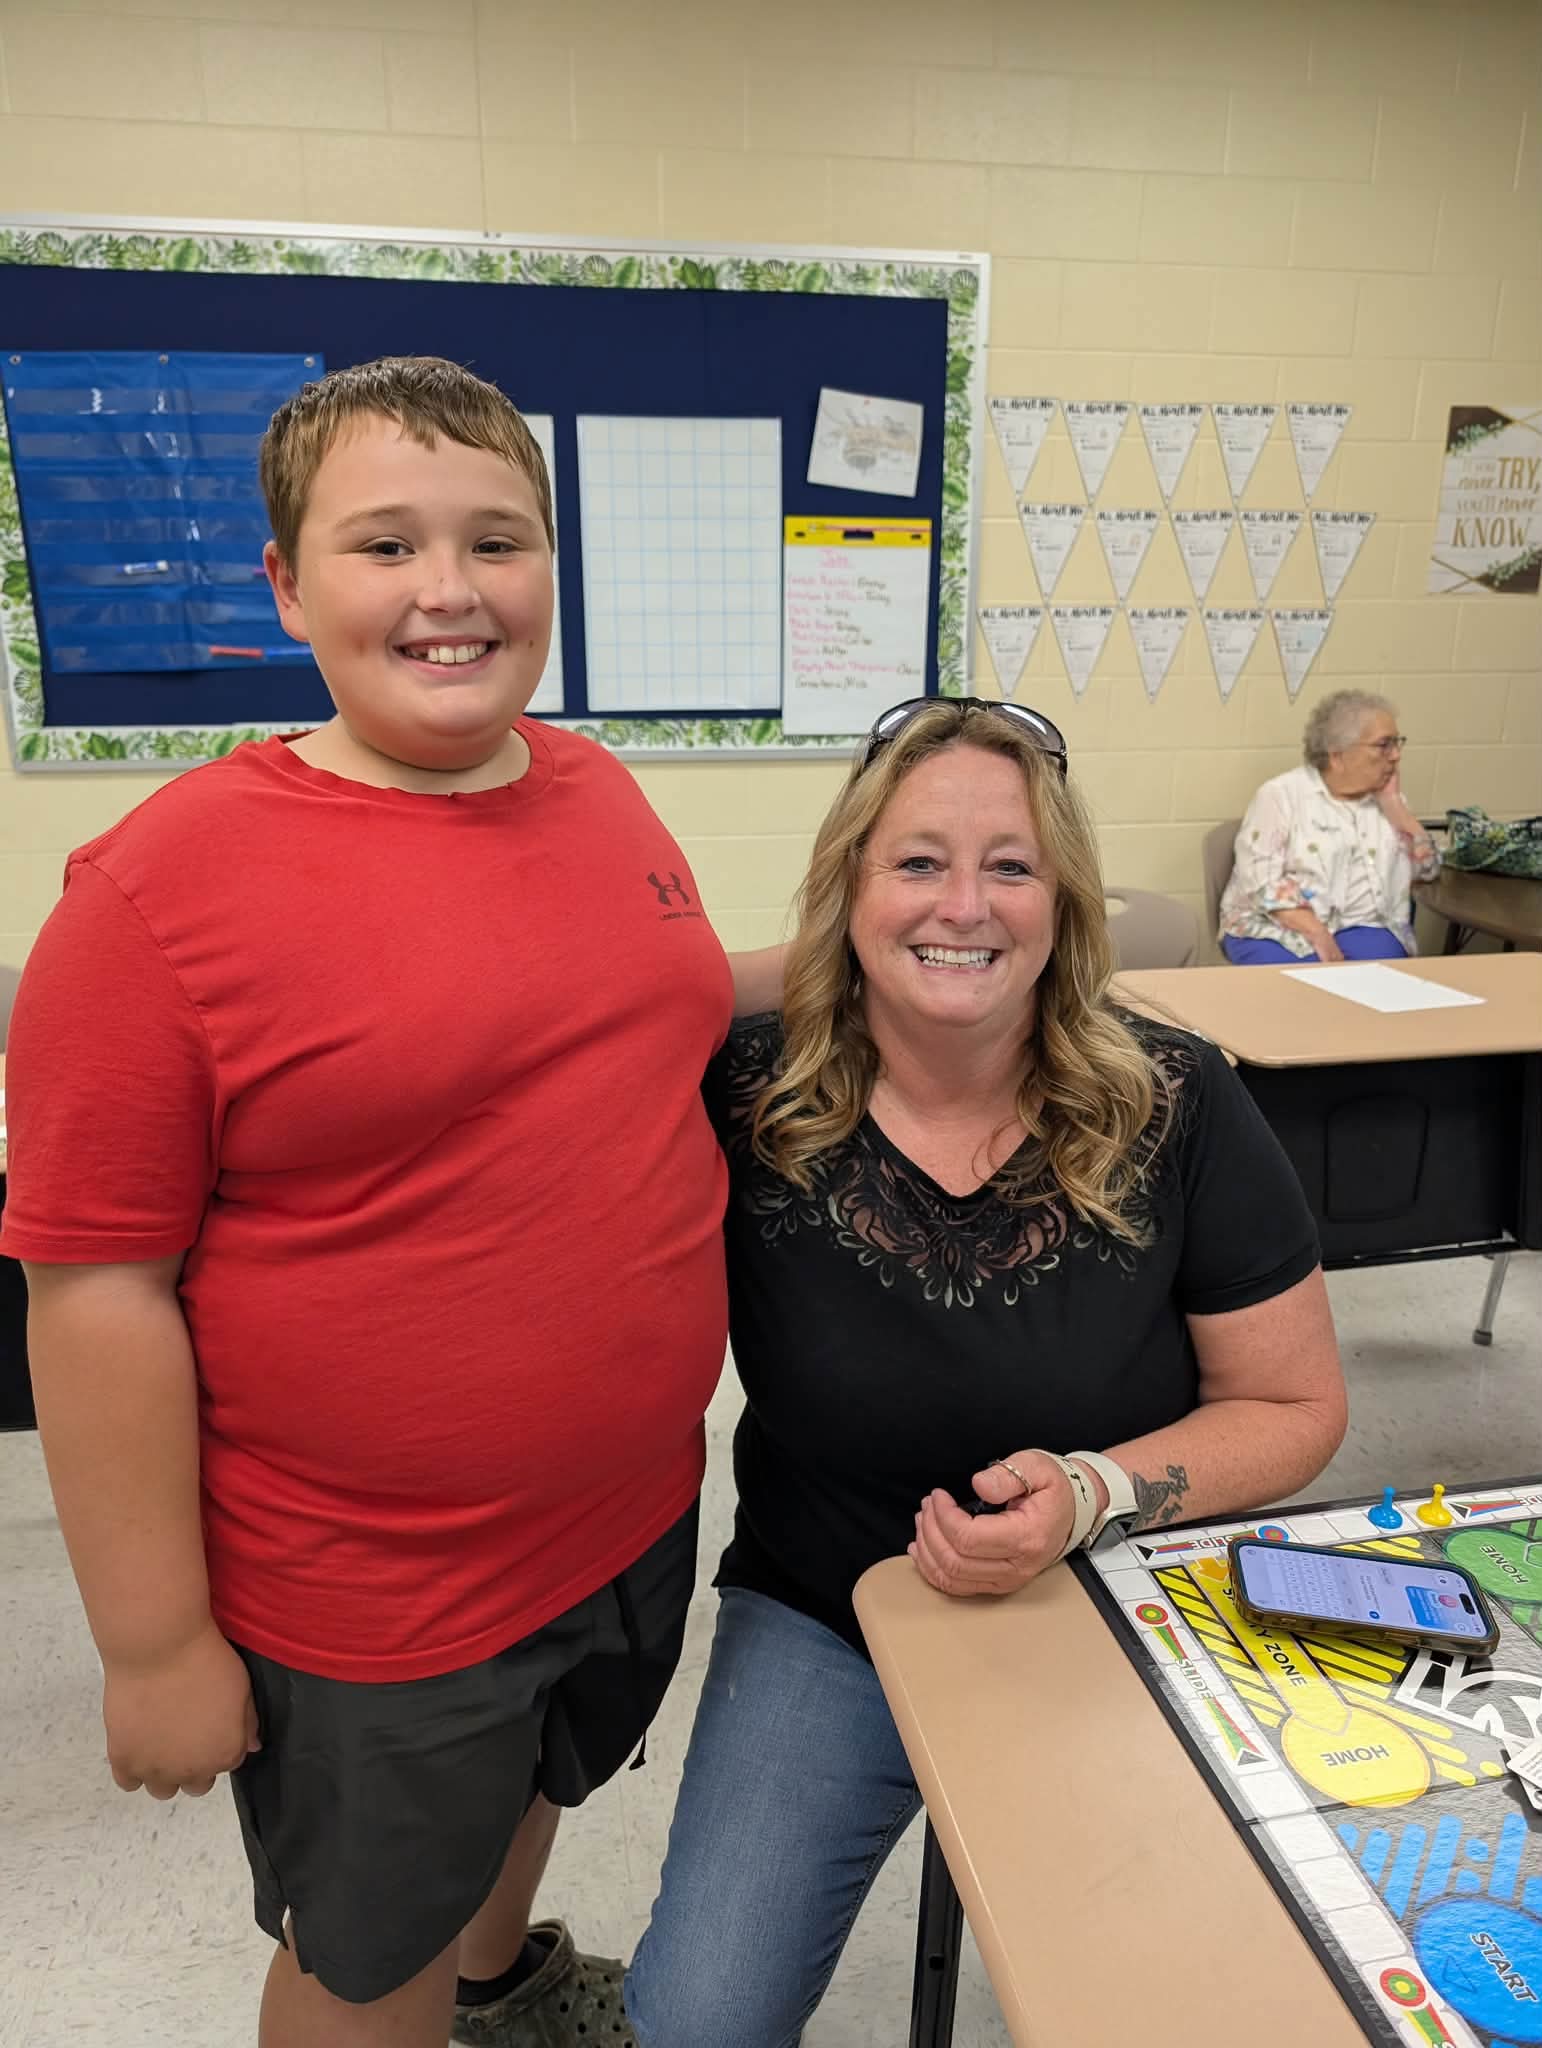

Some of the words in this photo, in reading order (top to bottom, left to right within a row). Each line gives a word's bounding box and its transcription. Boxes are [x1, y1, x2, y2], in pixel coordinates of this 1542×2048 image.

[1453, 516, 1533, 548] KNOW
[1480, 1544, 1529, 1584] HOME
[1175, 1658, 1214, 1698] SLIDE
[1263, 1642, 1307, 1686] ZONE
[1319, 1744, 1390, 1767] HOME
[1470, 1932, 1539, 2002] START
